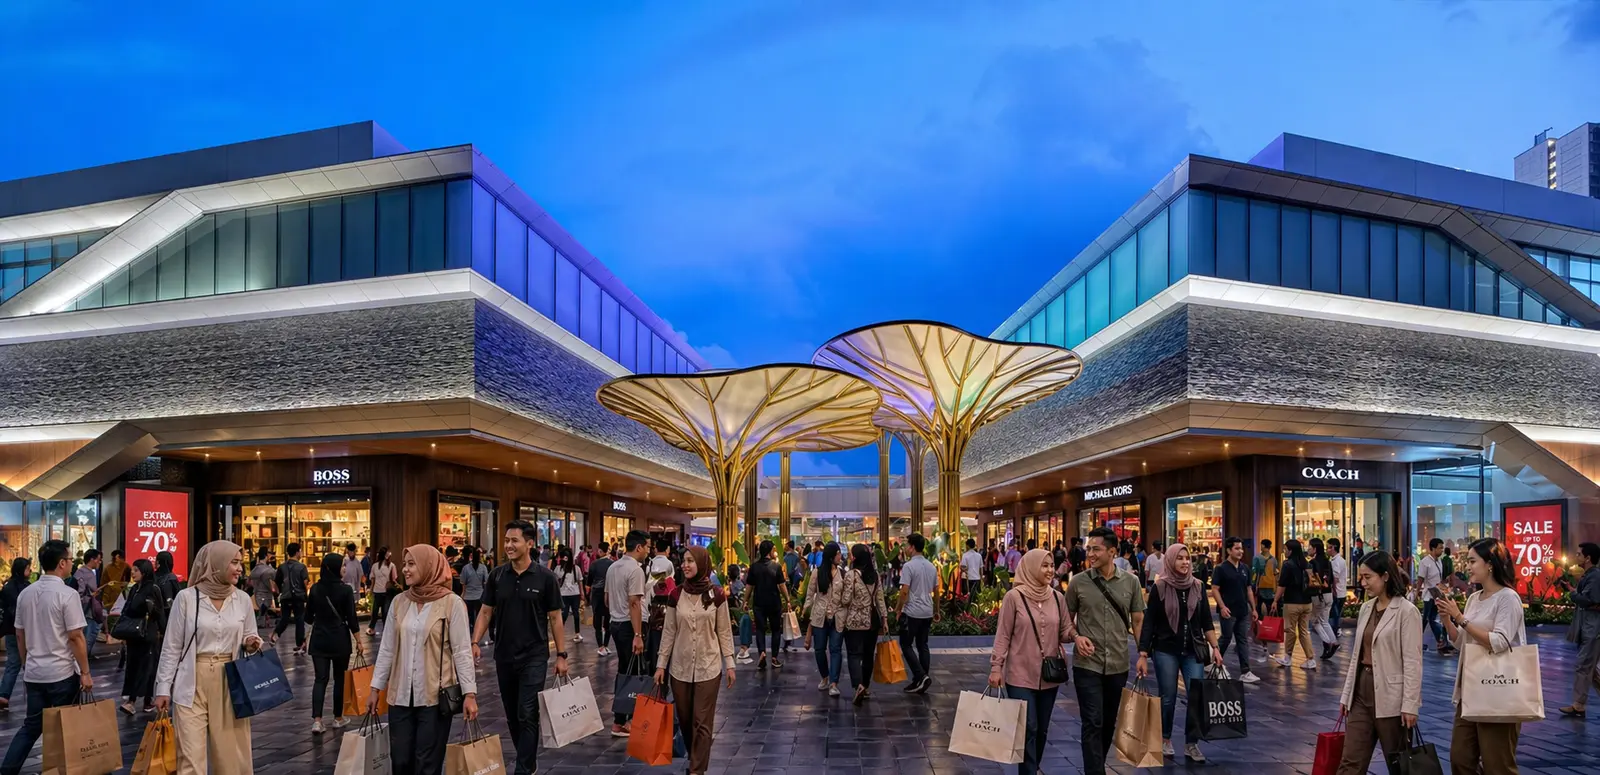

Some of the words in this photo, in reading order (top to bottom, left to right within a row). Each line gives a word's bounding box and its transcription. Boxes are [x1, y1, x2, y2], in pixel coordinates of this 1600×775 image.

[313, 469, 350, 481] BOSS
[1301, 467, 1360, 480] COACH
[1084, 488, 1112, 501] MICHAEL
[1113, 485, 1133, 496] KORS
[143, 511, 172, 520] EXTRA
[137, 520, 178, 528] DISCOUNT
[1513, 520, 1553, 535] SALE
[1513, 544, 1554, 565] 70%
[1520, 566, 1542, 576] OFF
[1208, 700, 1242, 717] BOSS
